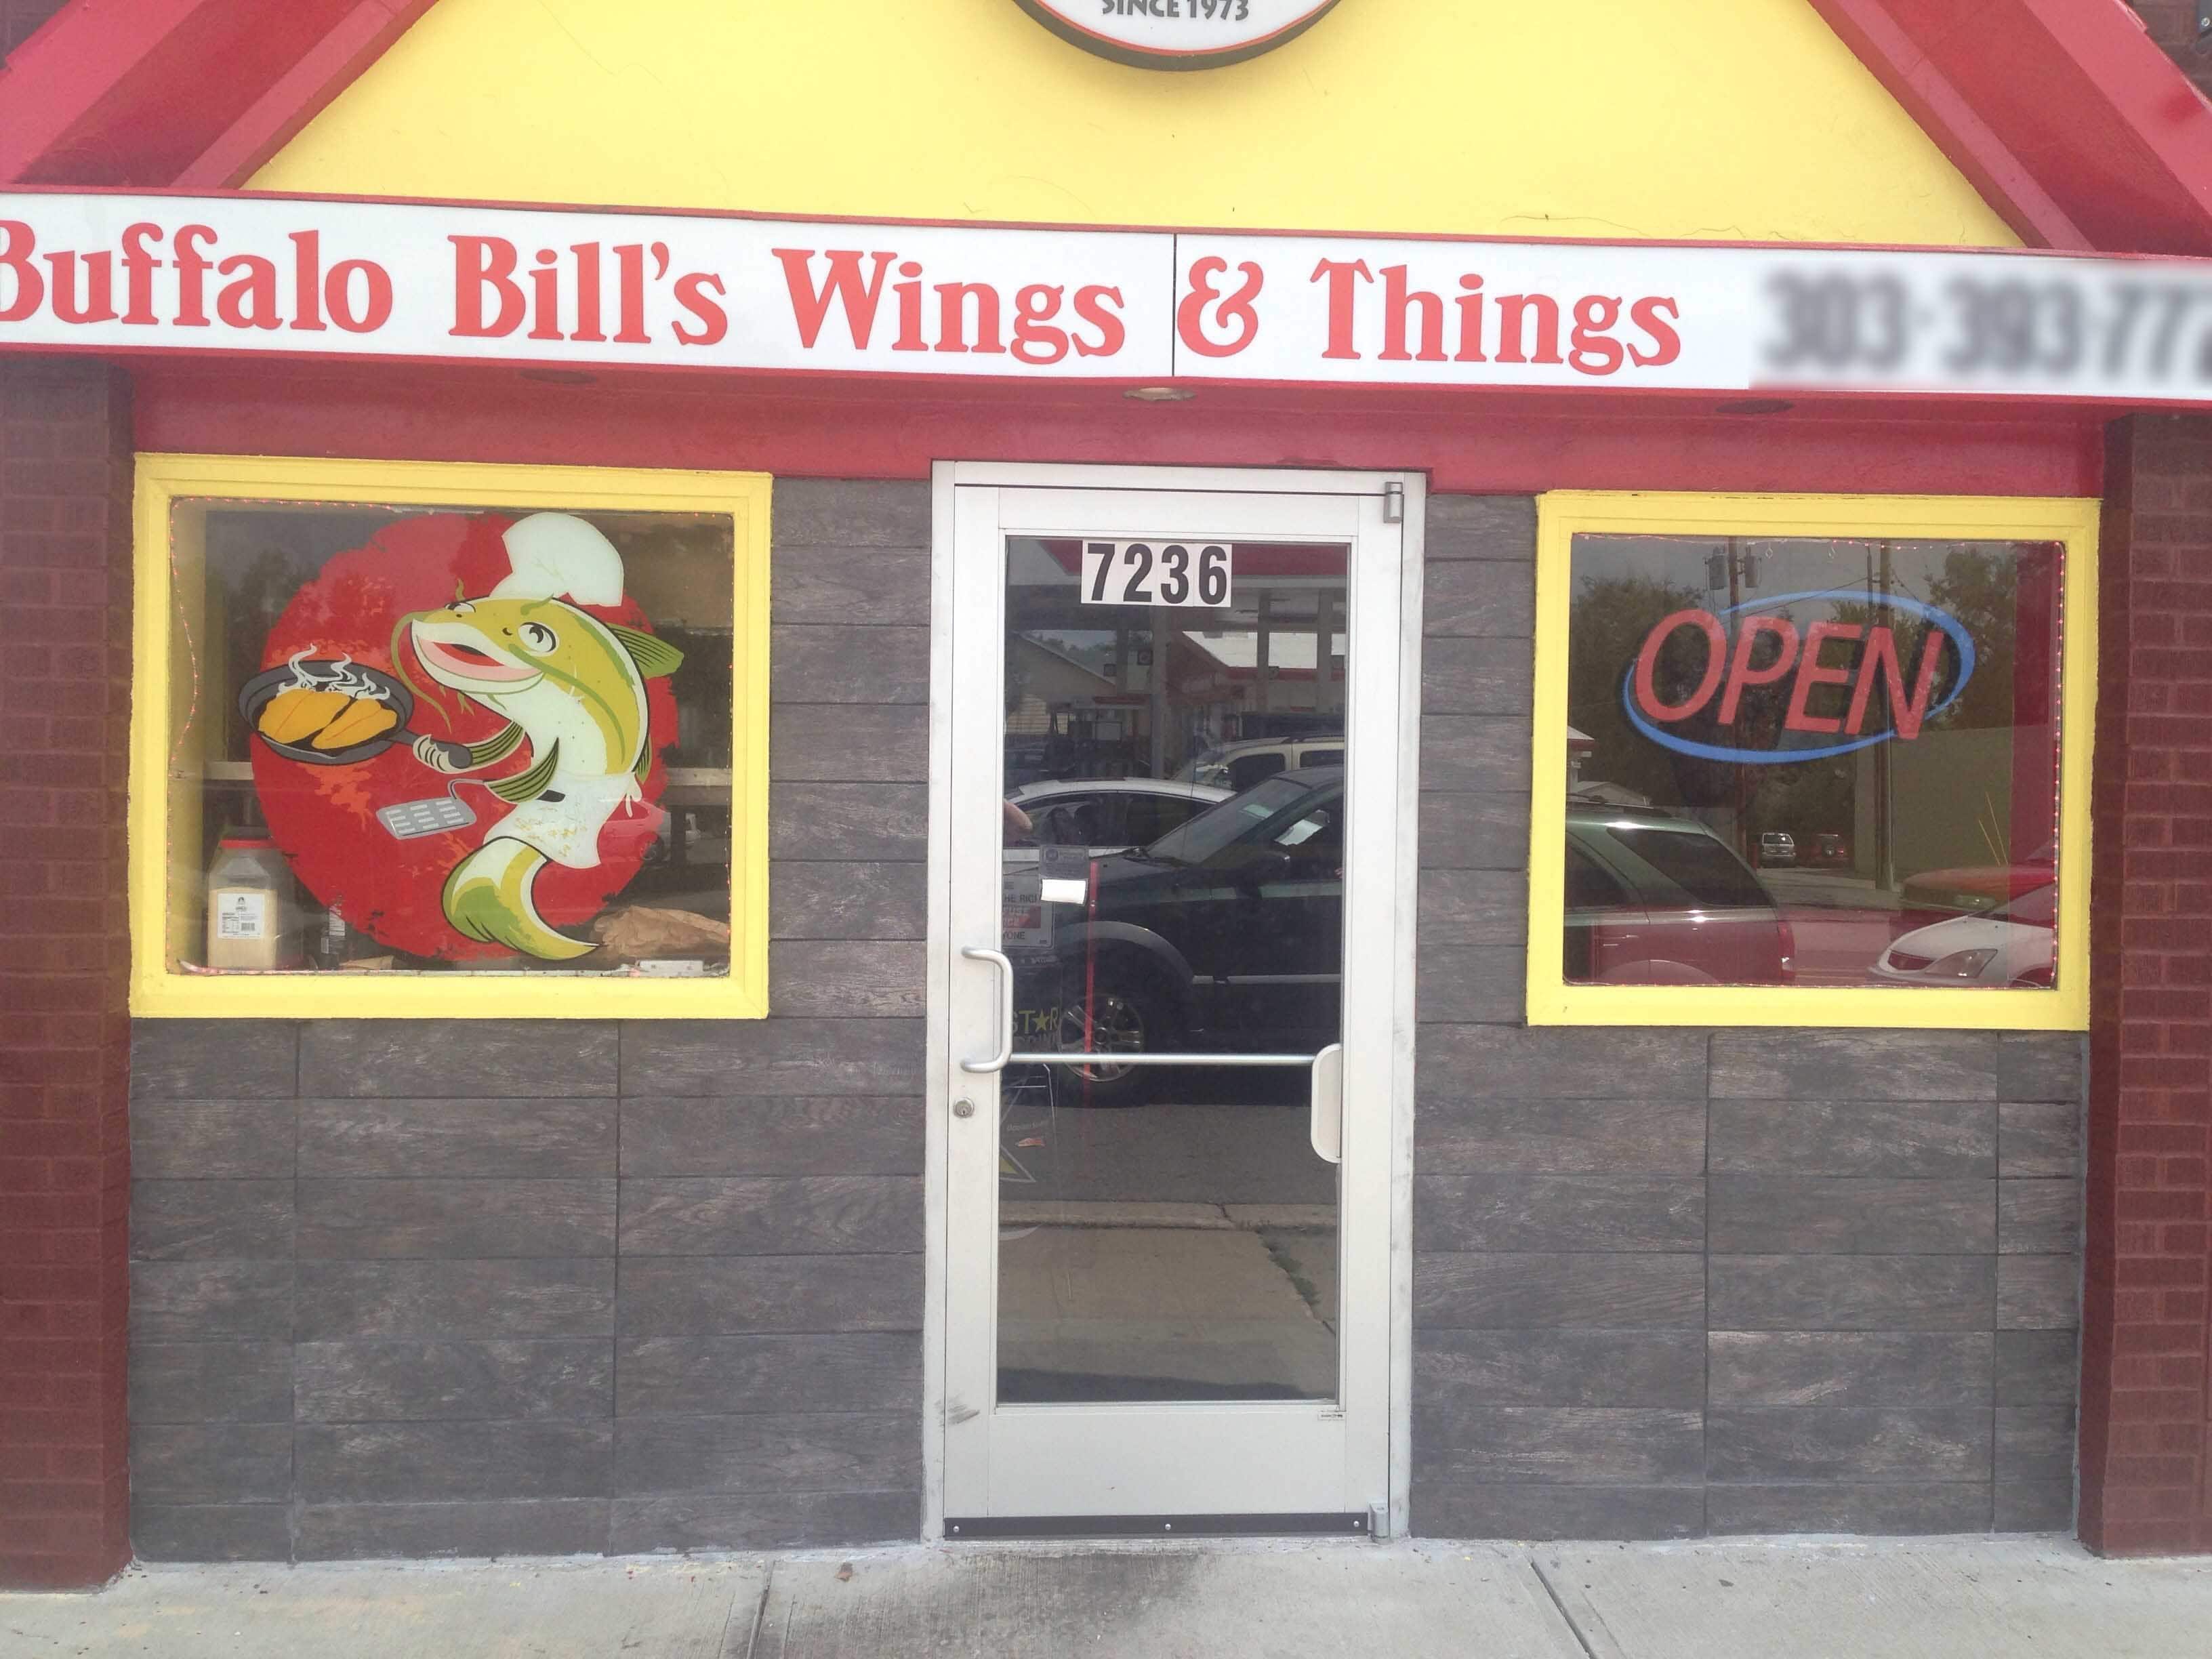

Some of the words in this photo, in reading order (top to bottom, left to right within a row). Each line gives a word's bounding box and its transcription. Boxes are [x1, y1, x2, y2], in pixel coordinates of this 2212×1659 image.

[1102, 0, 1180, 18] SINCE
[447, 234, 729, 346] Bill's
[771, 248, 1125, 365] Wings
[1176, 255, 1264, 358] &
[1309, 258, 1682, 376] Things
[1087, 542, 1227, 605] 7236
[1635, 609, 1944, 740] OPEN
